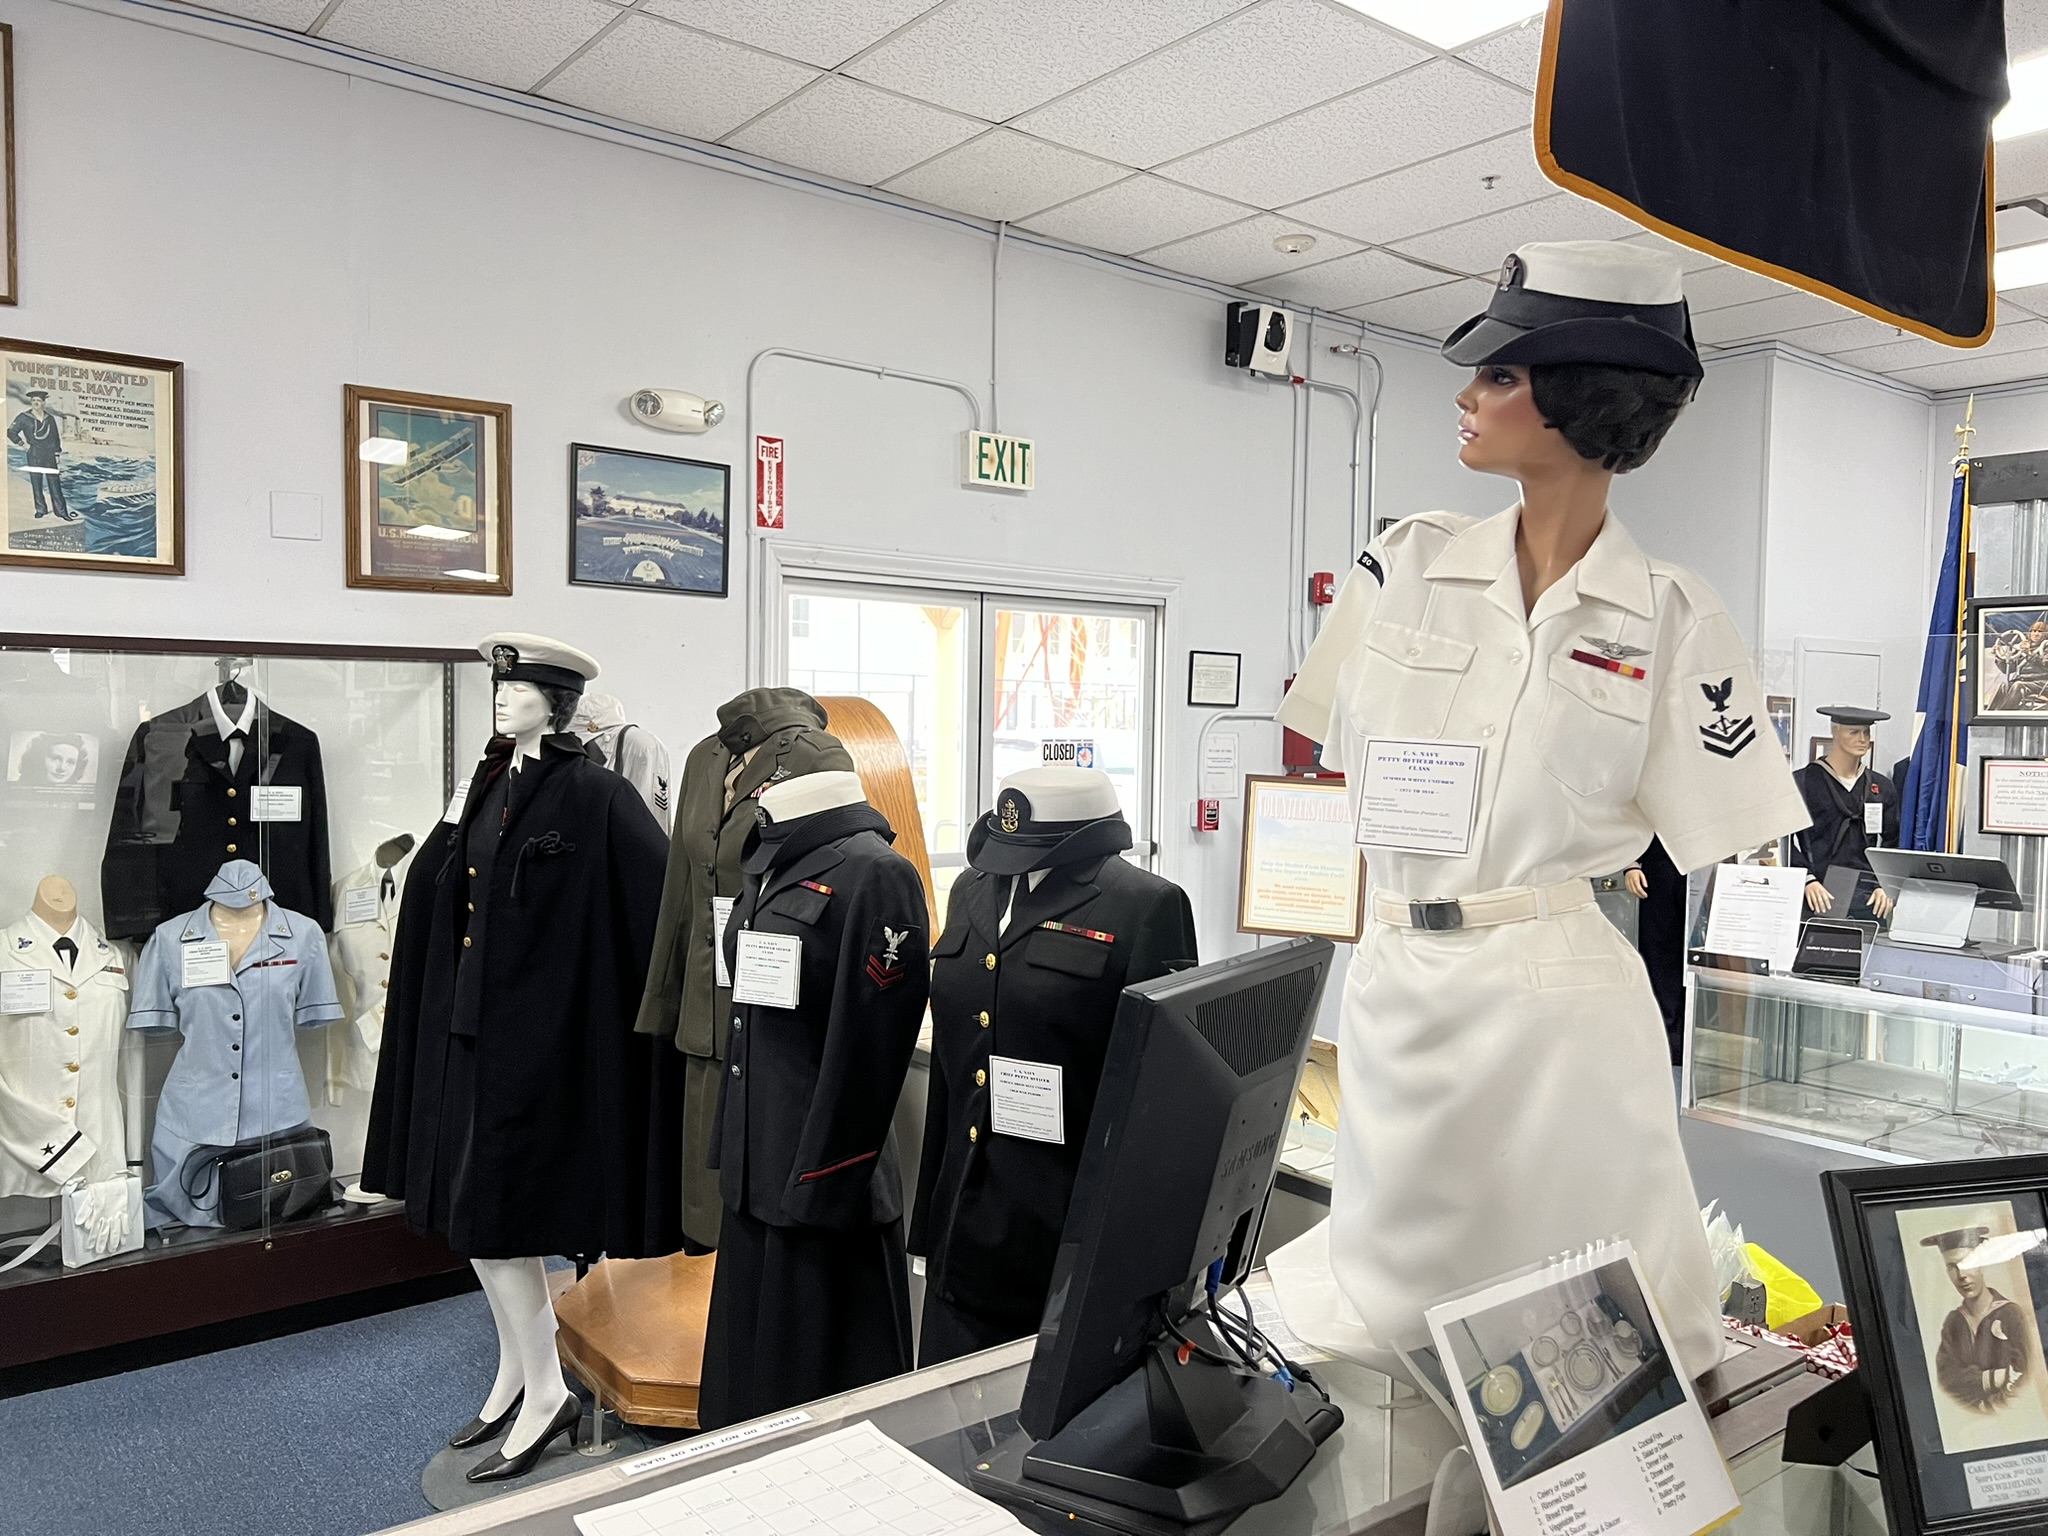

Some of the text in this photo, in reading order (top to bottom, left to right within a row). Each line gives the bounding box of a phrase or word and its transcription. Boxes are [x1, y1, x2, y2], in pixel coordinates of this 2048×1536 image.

[8, 360, 149, 387] YOUNG MEN WANTED
[31, 376, 56, 390] FOR
[86, 383, 125, 398] NAVY.
[761, 445, 779, 459] FIRE
[978, 436, 1030, 485] EXIT
[1043, 743, 1075, 761] CLOSED
[1260, 797, 1352, 824] VOLUNTEERS NEEDE
[1221, 1131, 1276, 1178] SAMSUNG
[721, 1434, 739, 1443] NOT
[1652, 1432, 1664, 1441] Fork
[1672, 1433, 1684, 1442] Fork
[690, 1442, 715, 1452] LEAN
[634, 1457, 666, 1468] GLASS
[1646, 1458, 1659, 1469] Dinner
[1659, 1452, 1669, 1462] Fork
[1649, 1468, 1664, 1479] Dinner
[1663, 1462, 1675, 1471] Knife
[1993, 1472, 2012, 1481] COOK
[1537, 1488, 1554, 1500] Celery
[1559, 1477, 1575, 1489] Relish
[1574, 1471, 1587, 1481] Dish
[1654, 1475, 1675, 1489] Teaspoon
[1672, 1480, 1686, 1492] Spoon
[1541, 1494, 1563, 1511] Rimmed
[1562, 1490, 1575, 1501] Soup
[1575, 1482, 1588, 1494] Bowl
[1663, 1499, 1677, 1510] Pastry
[1676, 1492, 1686, 1502] Fork
[1545, 1510, 1561, 1522] Bread
[1560, 1503, 1574, 1513] Plate
[1549, 1516, 1574, 1532] Vegetable
[1574, 1508, 1587, 1520] Bowl
[1569, 1522, 1587, 1535] Saucer
[1604, 1516, 1621, 1530] Saucer
